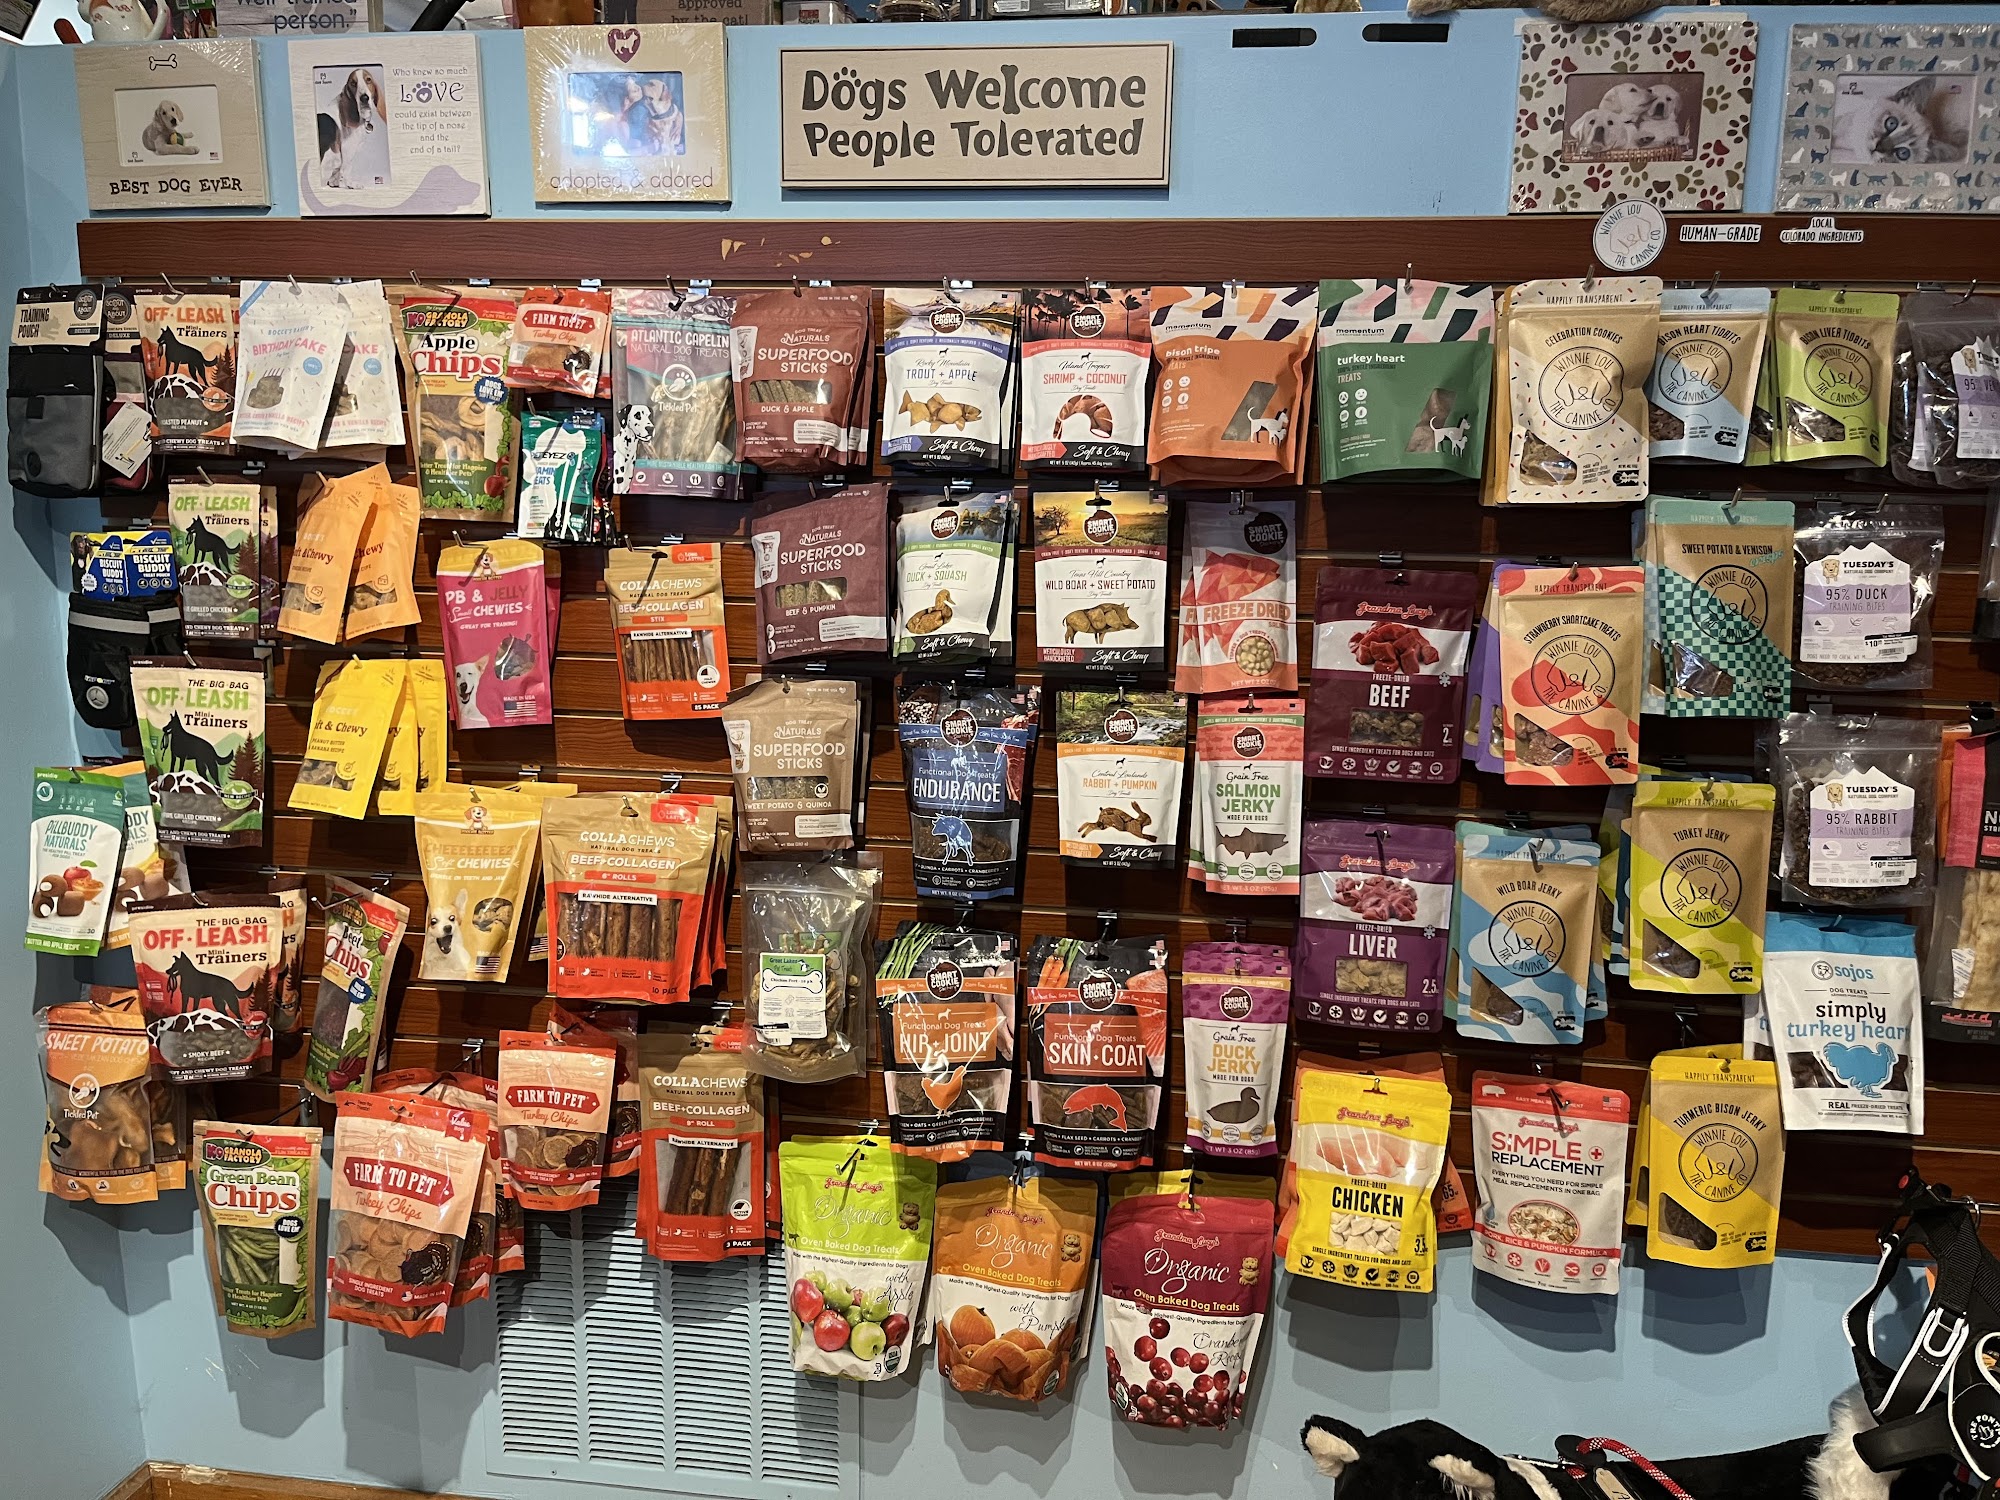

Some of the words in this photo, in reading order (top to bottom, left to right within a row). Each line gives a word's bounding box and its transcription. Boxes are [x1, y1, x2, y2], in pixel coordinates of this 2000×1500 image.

[678, 0, 742, 10] approved
[447, 67, 467, 75] much
[802, 67, 906, 120] Dogs
[925, 65, 1146, 114] Welcome
[395, 110, 416, 119] could
[419, 110, 437, 119] exist
[439, 110, 471, 118] between
[416, 122, 427, 131] tip
[429, 122, 437, 130] of
[420, 133, 435, 141] and
[437, 133, 449, 141] the
[803, 120, 935, 168] People
[950, 118, 1143, 157] Tolerated
[410, 145, 424, 154] end
[427, 145, 435, 154] of
[444, 145, 460, 153] tail?
[110, 179, 149, 195] BEST
[158, 178, 190, 193] DOG
[200, 177, 242, 192] EVER
[550, 169, 622, 189] adopted
[632, 169, 644, 188] &
[651, 168, 713, 188] adored
[1812, 218, 1833, 228] LOCAL
[1782, 231, 1815, 241] COLORADO
[1819, 231, 1862, 241] INGREDIENTS
[1547, 295, 1573, 304] HAPPILY
[1577, 294, 1622, 304] TRANSPARENT
[21, 308, 50, 323] TRAINING
[144, 307, 169, 323] OFF
[177, 307, 225, 323] LEASH
[18, 324, 39, 338] POUCH
[177, 327, 227, 338] Trainers
[632, 330, 682, 344] ATLANTIC
[685, 333, 730, 348] CAPELIN
[1545, 327, 1591, 347] CELEBRATION
[1593, 327, 1623, 344] COOKIES
[253, 339, 295, 356] BIRTHDAY
[296, 338, 327, 355] CAKE
[421, 335, 475, 351] Apple
[631, 343, 671, 354] NATURAL
[674, 345, 692, 355] DOG
[696, 348, 729, 358] TREATS
[1165, 346, 1192, 357] bison
[1194, 345, 1220, 357] tripe
[412, 350, 501, 378] Chips
[758, 348, 853, 366] SUPERFOOD
[1337, 354, 1373, 366] turkey
[1375, 353, 1405, 363] heart
[781, 362, 828, 374] STICKS
[906, 369, 936, 379] TROUT
[949, 370, 977, 381] APPLE
[1043, 373, 1075, 384] SHRIMP
[1086, 373, 1127, 384] COCONUT
[1337, 372, 1362, 384] TREATS
[1682, 544, 1705, 555] SWEET
[1707, 544, 1734, 555] POTATO
[1735, 544, 1741, 555] &
[1742, 544, 1773, 555] VENISON
[133, 555, 170, 564] BISCUIT
[138, 563, 171, 573] BUDDY
[1045, 580, 1063, 590] WILD
[1066, 580, 1086, 590] BOAR
[1097, 580, 1124, 590] SWEET
[1127, 579, 1155, 590] POTATO
[445, 590, 466, 605] PB
[472, 590, 483, 603] &
[489, 585, 528, 600] JELLY
[1826, 588, 1850, 601] 95%
[1856, 588, 1888, 600] DUCK
[1204, 602, 1254, 621] FREEZE
[1256, 602, 1291, 620] DRIED
[1829, 602, 1863, 611] TRAINING
[1867, 602, 1885, 611] BITES
[1523, 615, 1560, 645] STRAWBERRY
[1562, 614, 1599, 630] SHORTCAKE
[1599, 621, 1621, 642] TREATS
[188, 679, 205, 687] THE
[209, 680, 225, 688] BIG
[230, 681, 249, 689] BAG
[1372, 674, 1410, 683] FREEZE-DRIED
[147, 686, 179, 707] OFF
[185, 688, 249, 710] LEASH
[1369, 683, 1411, 708] BEEF
[184, 714, 248, 729] Trainers
[913, 777, 1001, 803] ENDURANCE
[1216, 784, 1281, 797] SALMON
[1221, 799, 1274, 813] JERKY
[1827, 813, 1849, 825] 95%
[1855, 813, 1897, 825] RABBIT
[44, 835, 87, 851] NATURALS
[1673, 828, 1703, 843] TURKEY
[1705, 828, 1730, 843] JERKY
[1349, 933, 1397, 958] LIVER
[1835, 963, 1873, 982] sojos
[1816, 1000, 1886, 1023] simply
[1787, 1020, 1855, 1042] turkey
[46, 1032, 89, 1053] SWEET
[91, 1037, 149, 1055] POTATO
[1213, 1044, 1256, 1059] DUCK
[1049, 1043, 1091, 1067] SKIN
[1102, 1045, 1146, 1067] COAT
[1207, 1059, 1260, 1075] JERKY
[517, 1089, 544, 1104] FARM
[547, 1091, 560, 1105] TO
[563, 1092, 586, 1109] PET
[521, 1109, 549, 1124] Turkey
[551, 1111, 578, 1125] Chips
[1673, 1103, 1712, 1129] TURMERIC
[1715, 1102, 1740, 1115] BISON
[1741, 1108, 1767, 1132] JERKY
[1491, 1150, 1604, 1177] REPLACEMENT
[209, 1170, 253, 1185] Green
[256, 1172, 296, 1187] Bean
[207, 1184, 297, 1215] Chips
[1332, 1186, 1403, 1218] CHICKEN
[975, 1222, 1052, 1268] Organic
[1485, 1229, 1502, 1242] PORK,
[1505, 1237, 1522, 1246] RICE
[1531, 1242, 1567, 1254] PUMPKIN
[1569, 1247, 1607, 1257] FORMULA
[963, 1263, 985, 1276] Oven
[987, 1267, 1015, 1280] Baked
[1016, 1272, 1033, 1285] Dog
[1035, 1275, 1062, 1287] Treats
